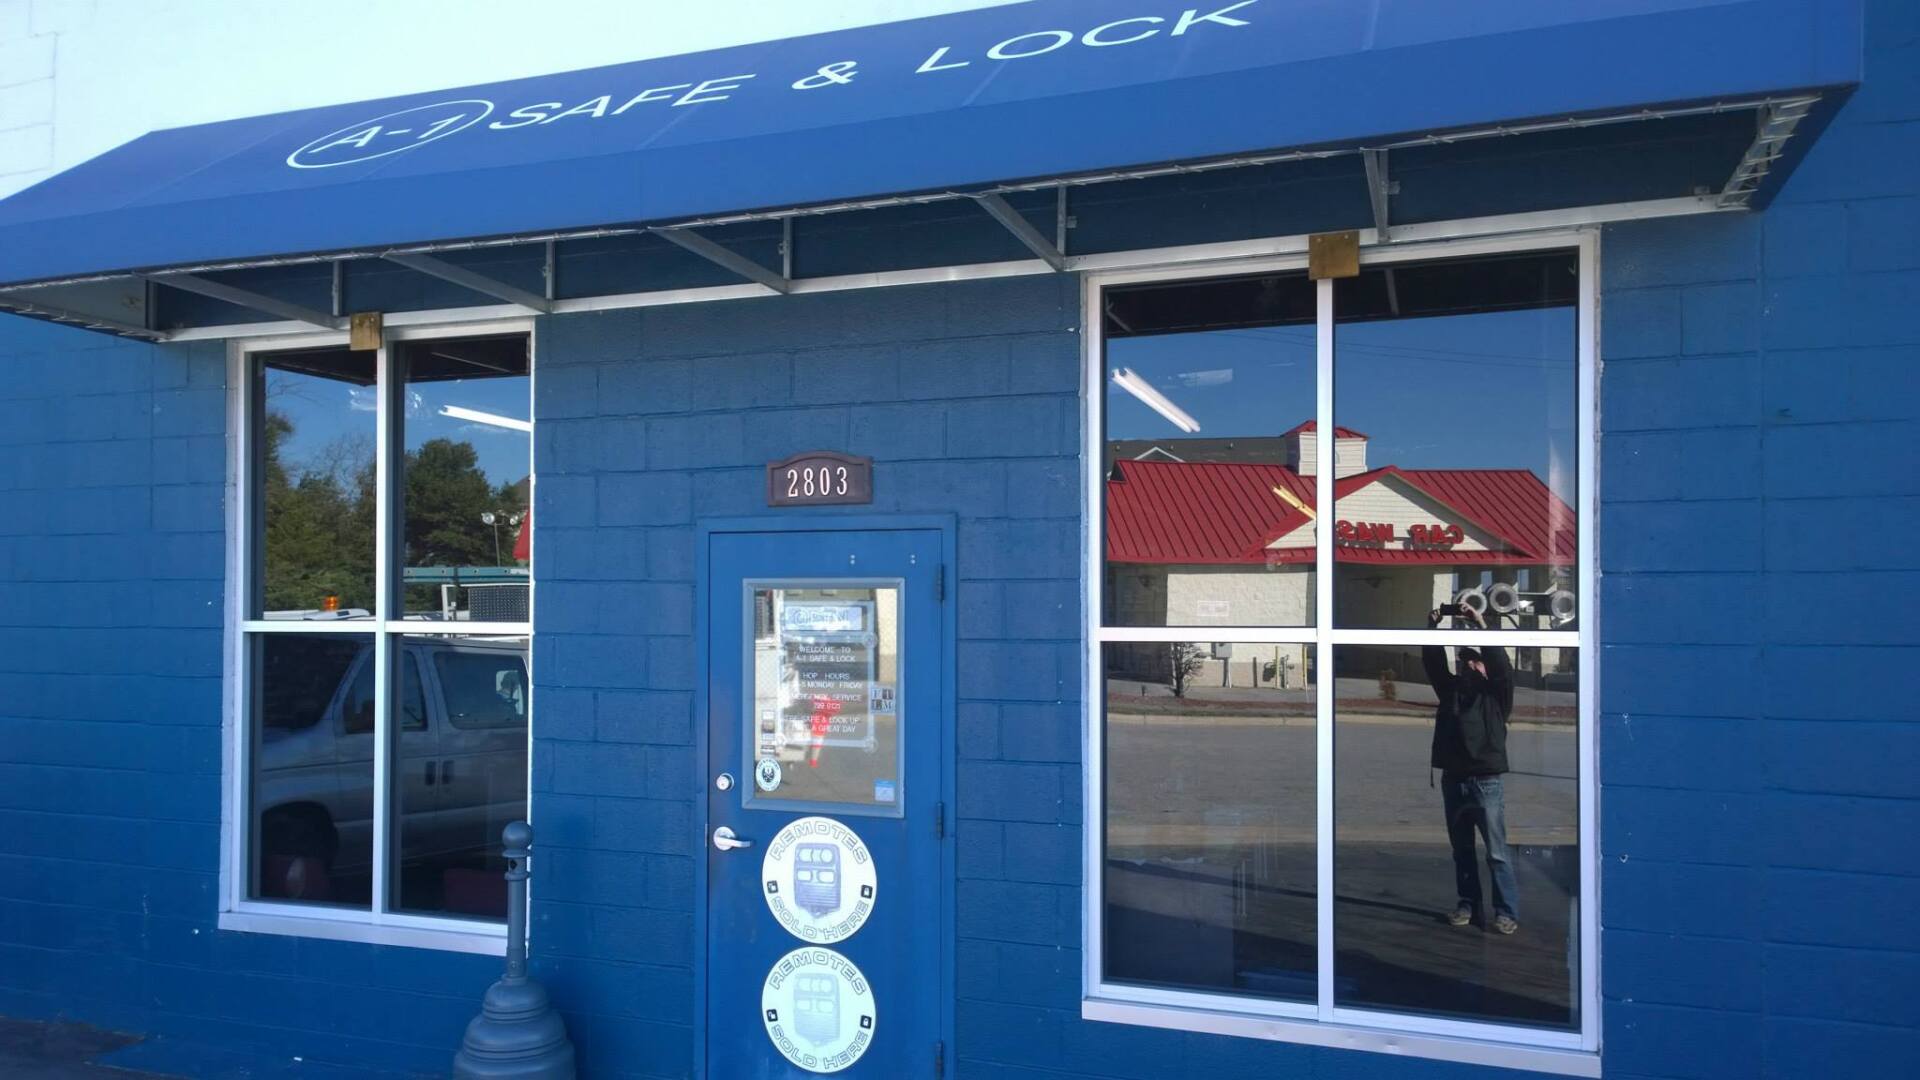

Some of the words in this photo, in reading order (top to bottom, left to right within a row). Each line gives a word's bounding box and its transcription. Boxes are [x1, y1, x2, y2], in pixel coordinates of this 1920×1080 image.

[308, 113, 465, 154] A-1
[489, 74, 757, 129] SAFE
[791, 61, 859, 90] &
[915, 0, 1260, 74] LOCK
[787, 466, 849, 498] 2803
[824, 672, 850, 681] HOURS
[769, 820, 869, 865] REMOTES
[770, 895, 818, 940] SOLD
[823, 899, 870, 941] HERE
[768, 950, 867, 996] REMOTES
[770, 1024, 818, 1068] SOLD
[823, 1030, 869, 1070] HERE
